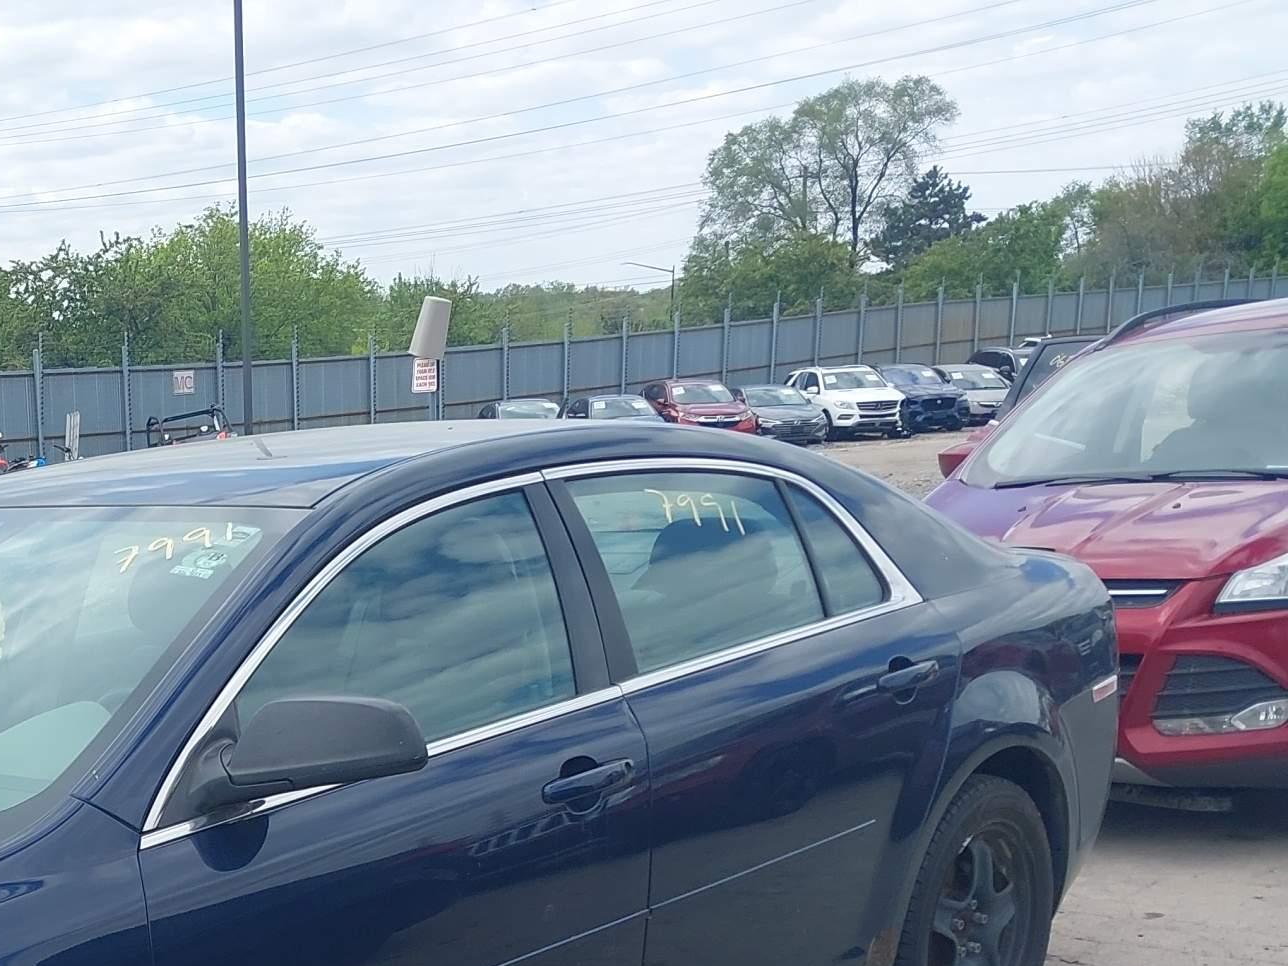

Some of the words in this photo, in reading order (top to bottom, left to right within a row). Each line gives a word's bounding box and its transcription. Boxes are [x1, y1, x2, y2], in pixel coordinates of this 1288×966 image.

[175, 376, 193, 391] MC
[644, 488, 745, 535] 7991
[113, 522, 232, 574] 7991
